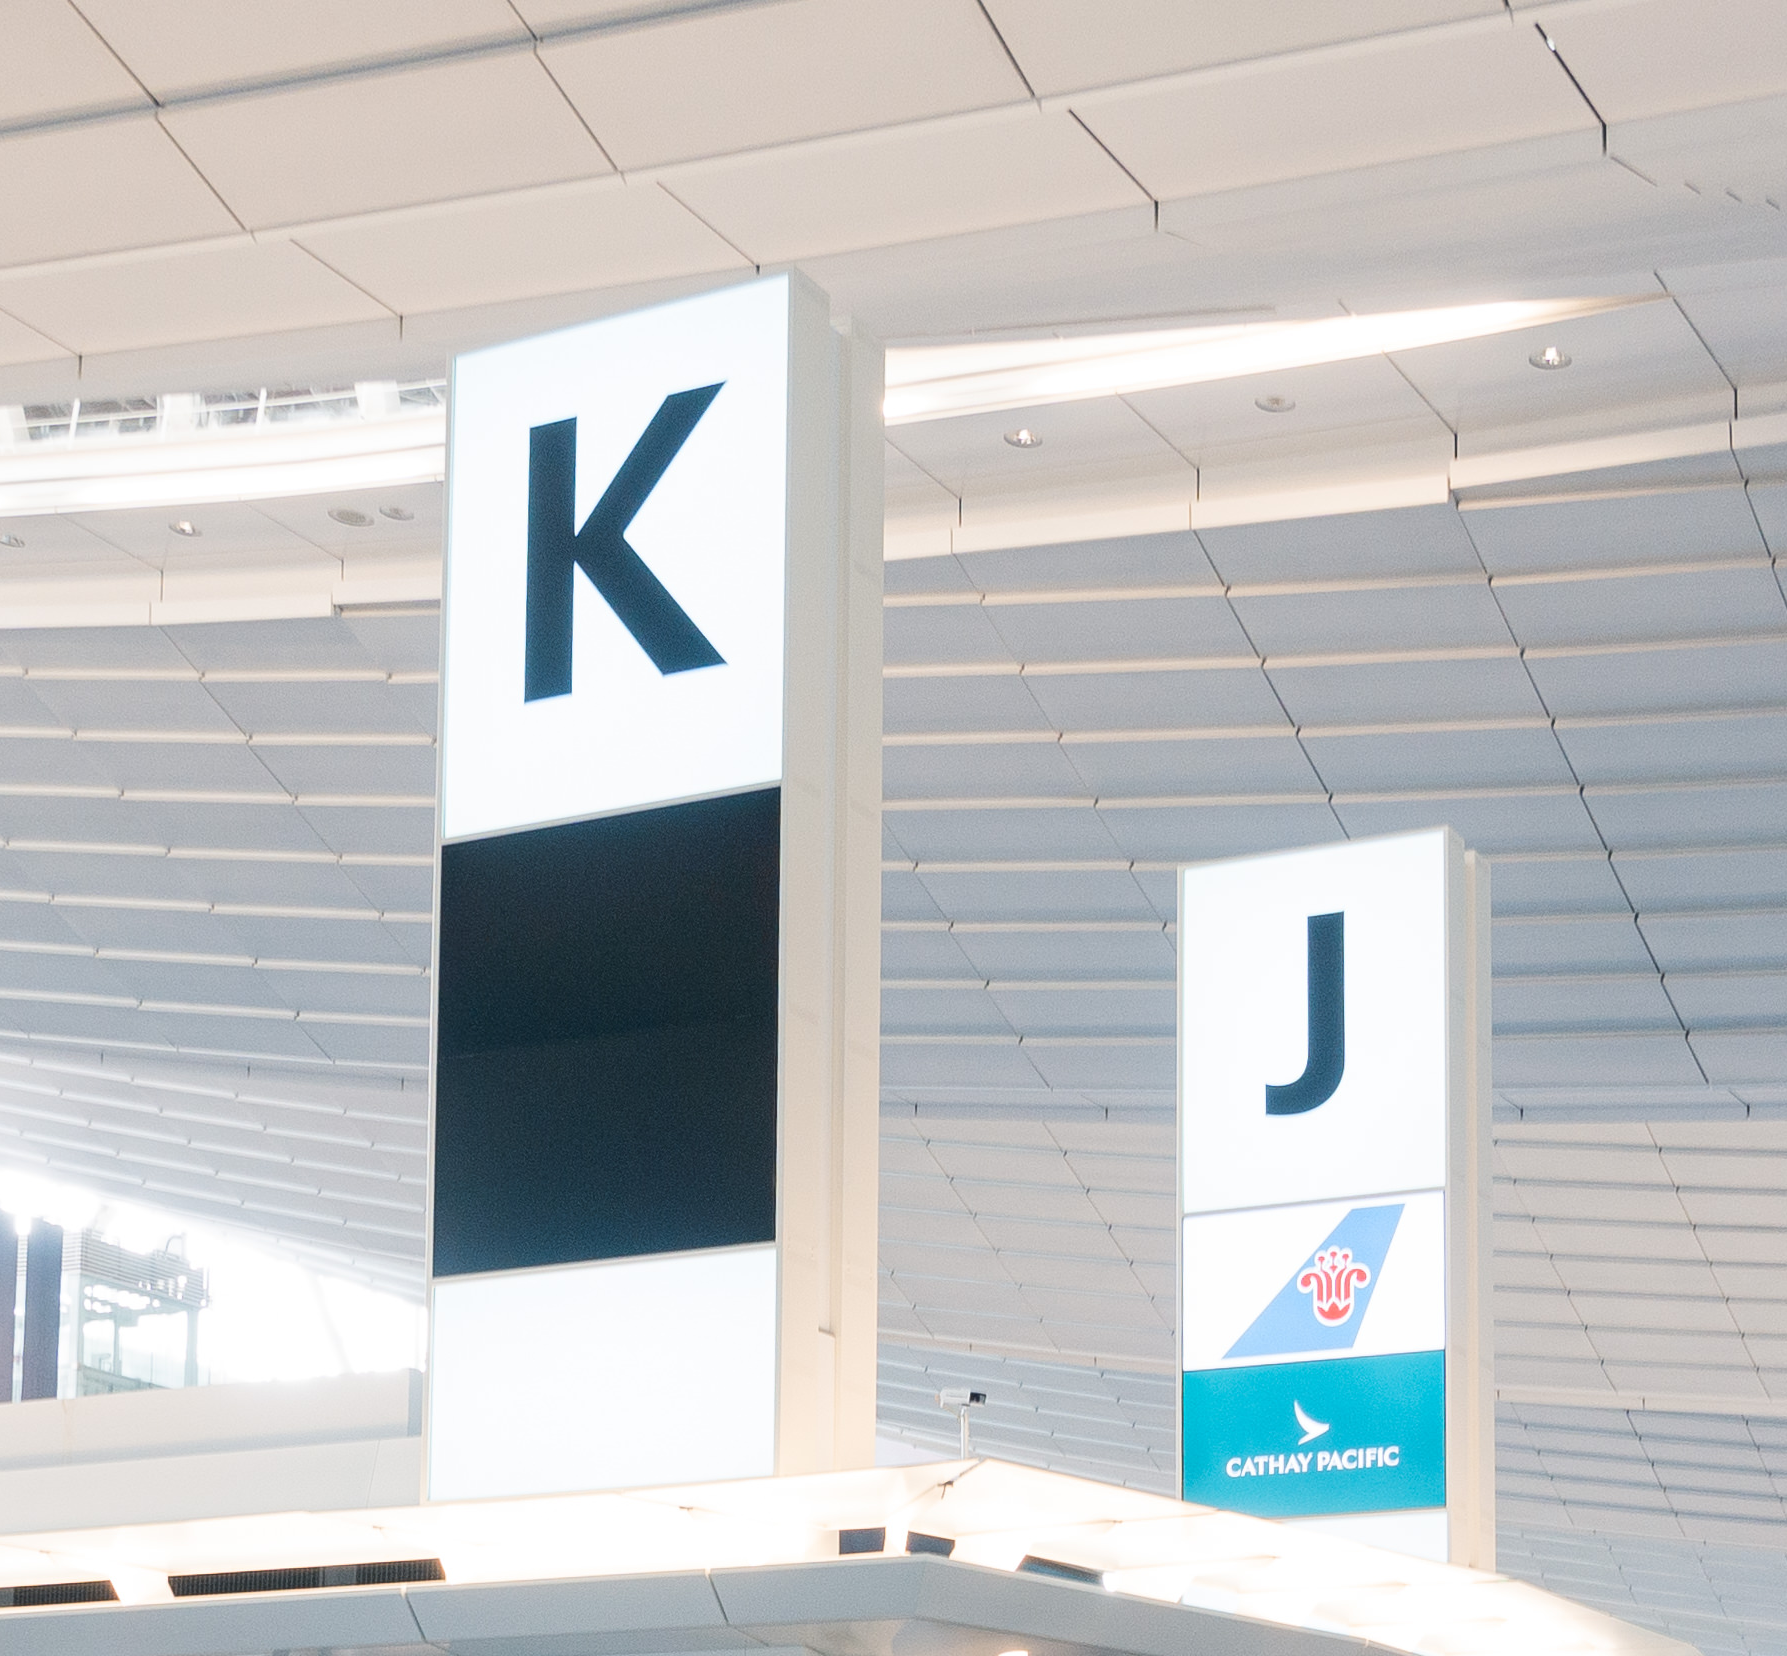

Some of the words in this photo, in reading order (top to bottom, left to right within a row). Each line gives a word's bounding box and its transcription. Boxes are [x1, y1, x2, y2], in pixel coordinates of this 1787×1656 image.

[523, 380, 728, 705] K
[1264, 911, 1346, 1117] J
[1226, 1453, 1313, 1478] CATHAY
[1316, 1446, 1400, 1471] PACIFIC
